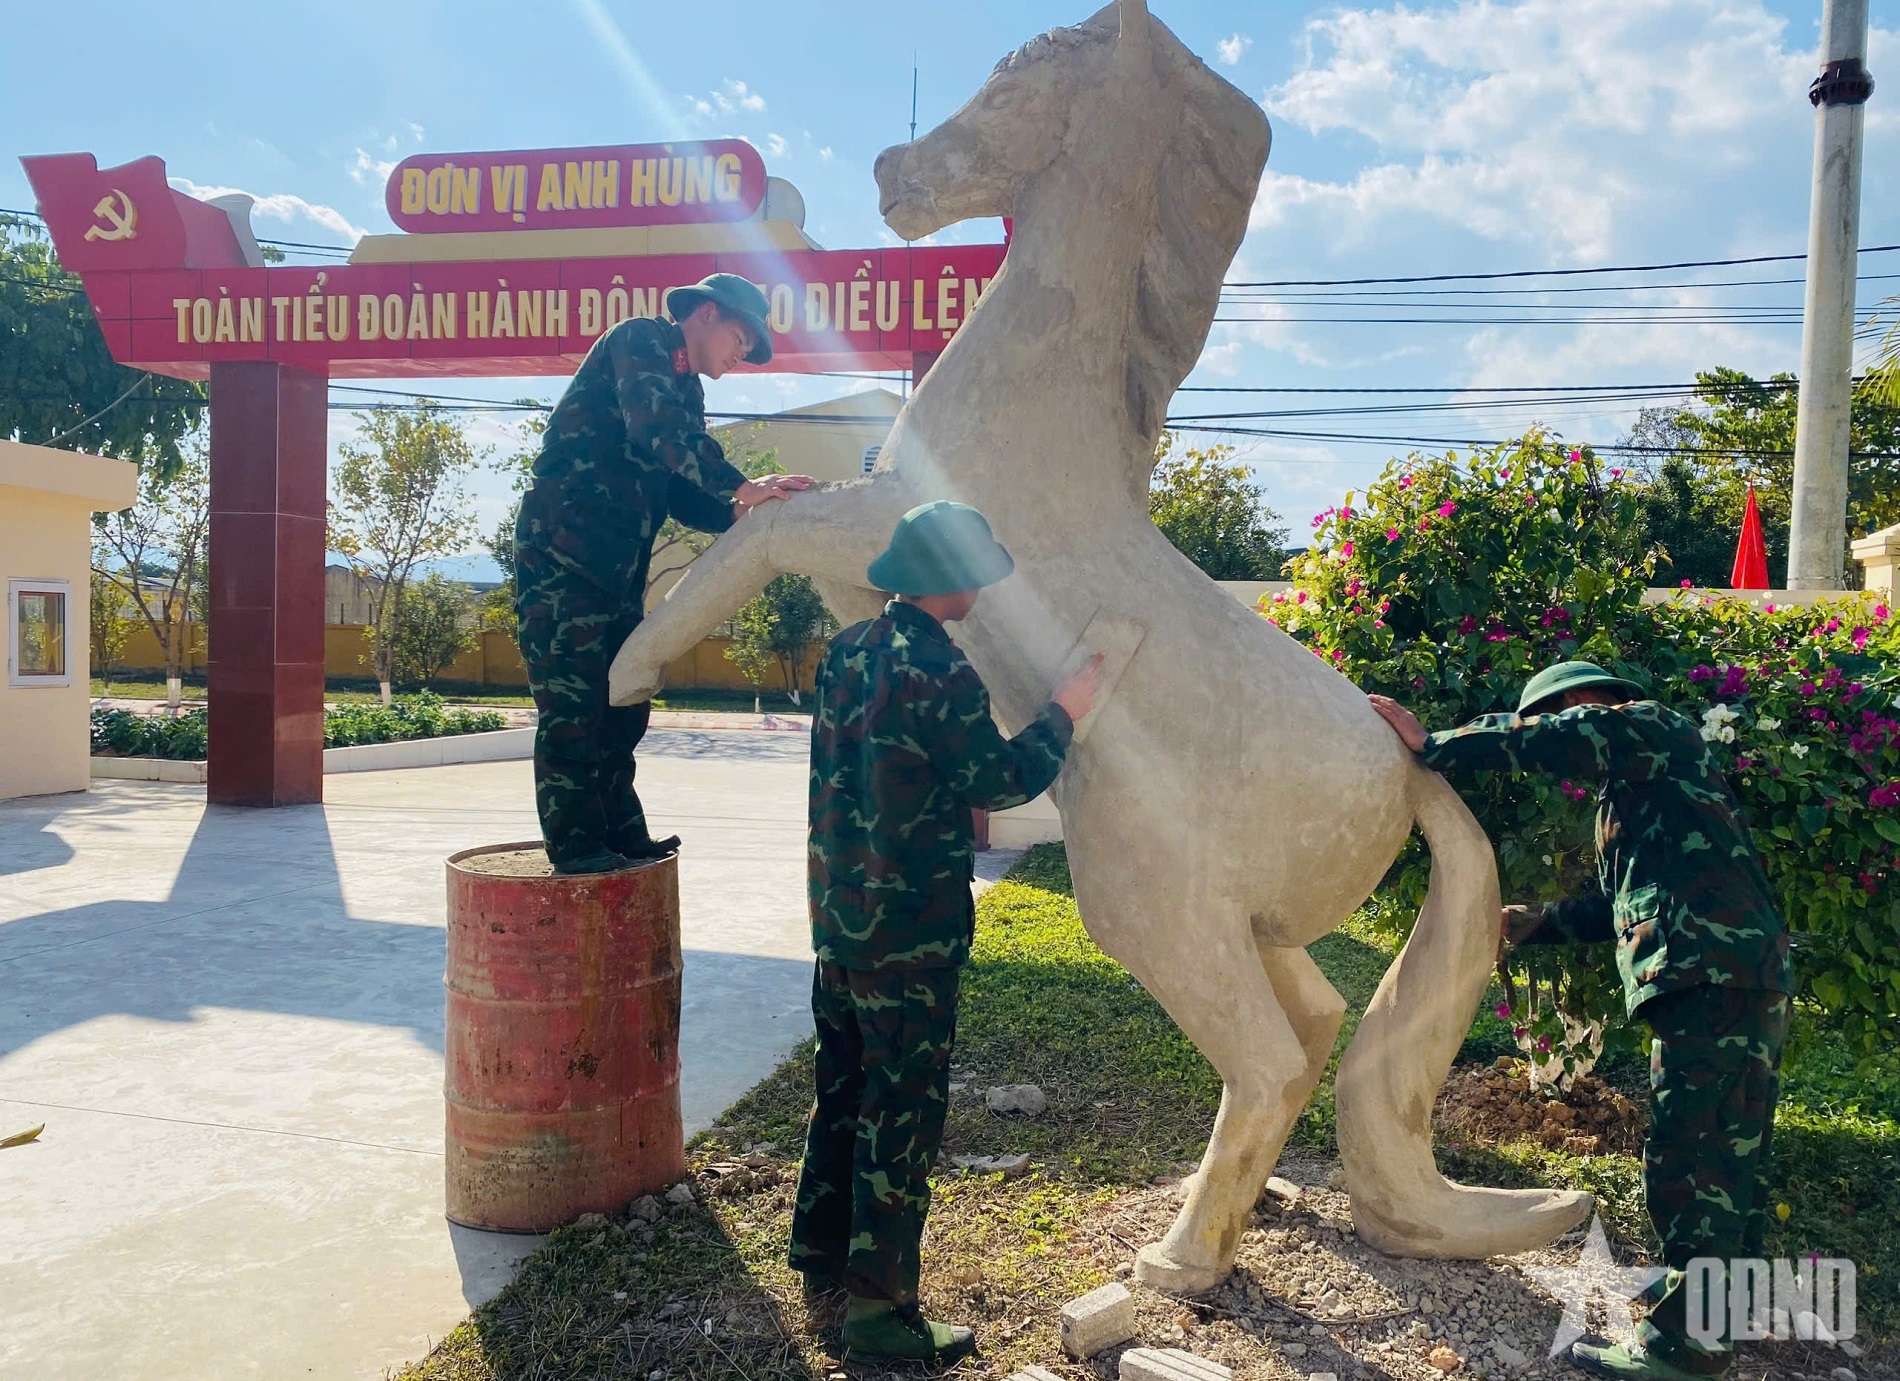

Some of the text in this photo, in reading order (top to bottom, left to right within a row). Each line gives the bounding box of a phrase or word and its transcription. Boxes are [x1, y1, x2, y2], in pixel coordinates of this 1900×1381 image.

[400, 143, 742, 222] ĐƠN VỊ ANH HÙNG
[173, 286, 264, 343] TOÀN
[271, 272, 349, 341] TIỂU
[357, 283, 457, 341] ĐOÀN
[466, 279, 568, 338] HÀNH
[804, 260, 900, 332] ĐIỀU
[913, 265, 992, 339] LỆN
